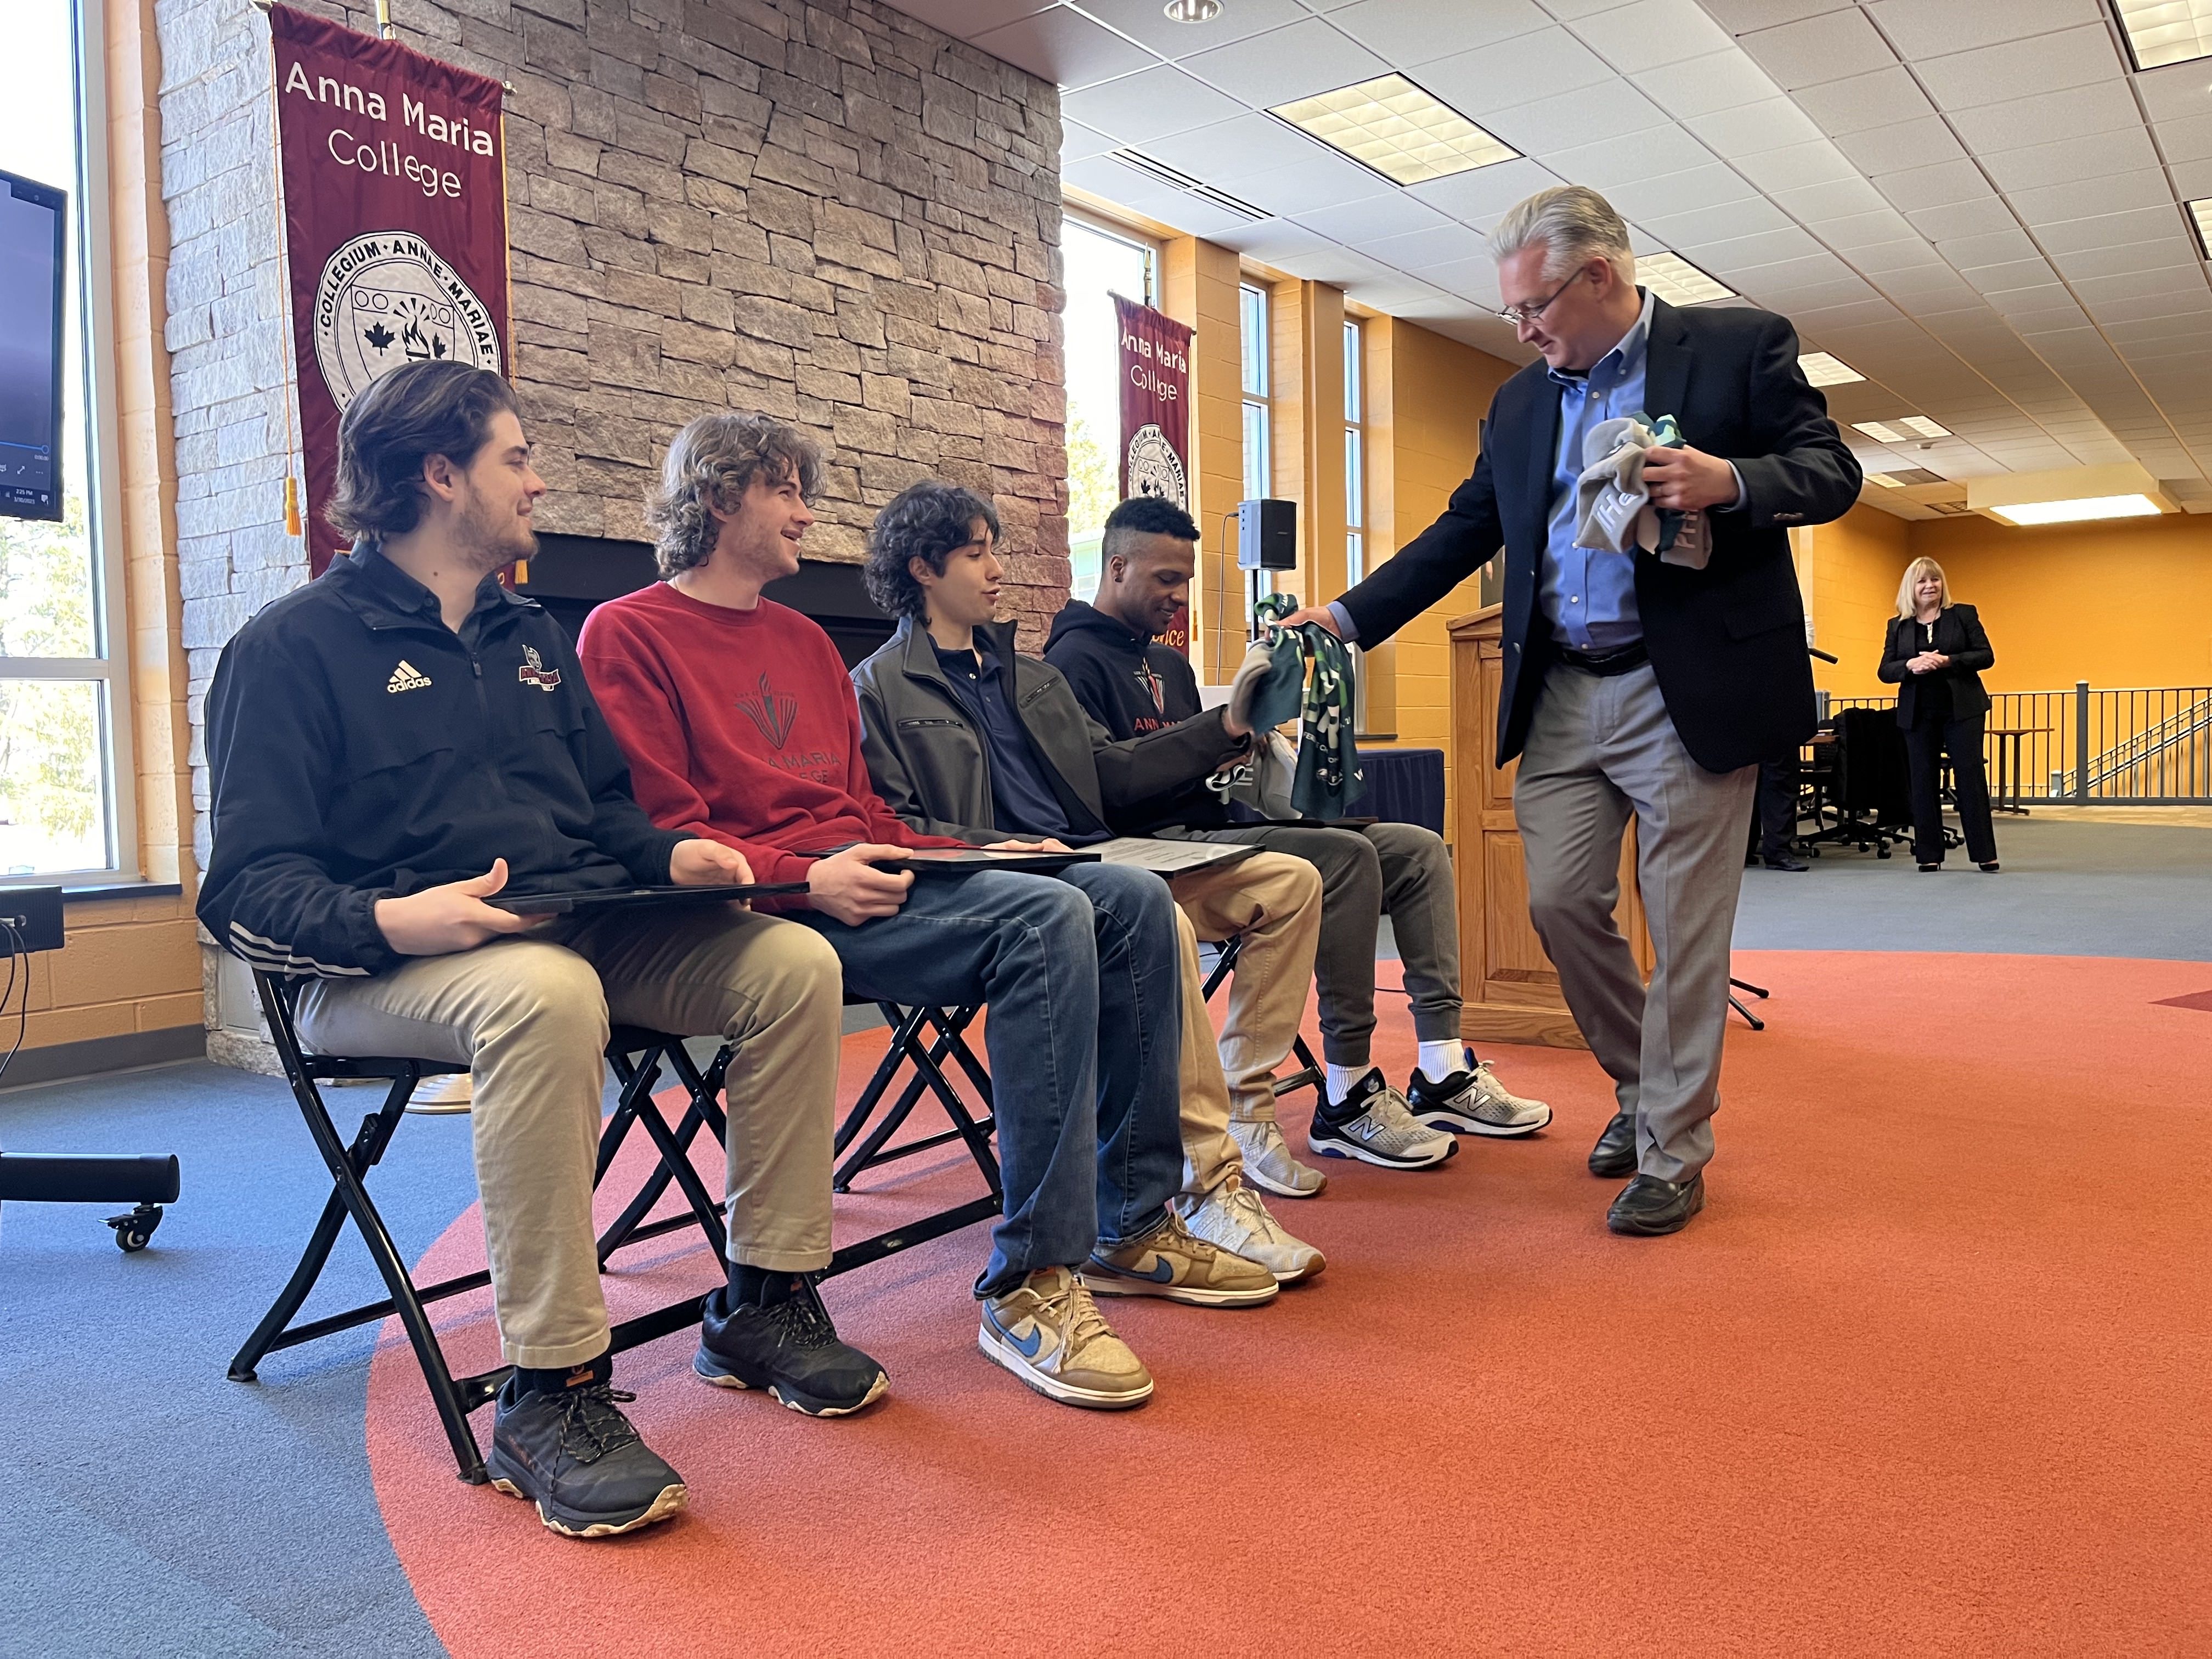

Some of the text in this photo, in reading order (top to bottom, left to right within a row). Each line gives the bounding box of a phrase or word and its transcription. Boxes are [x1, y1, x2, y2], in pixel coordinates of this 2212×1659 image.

[285, 61, 494, 157] Anna Maria
[328, 128, 462, 197] College
[320, 241, 381, 328] COLLEGIUM
[448, 282, 494, 356] MARIAE
[1121, 327, 1186, 373] Anna Maria
[387, 676, 432, 693] adidas
[781, 752, 842, 769] MARIA
